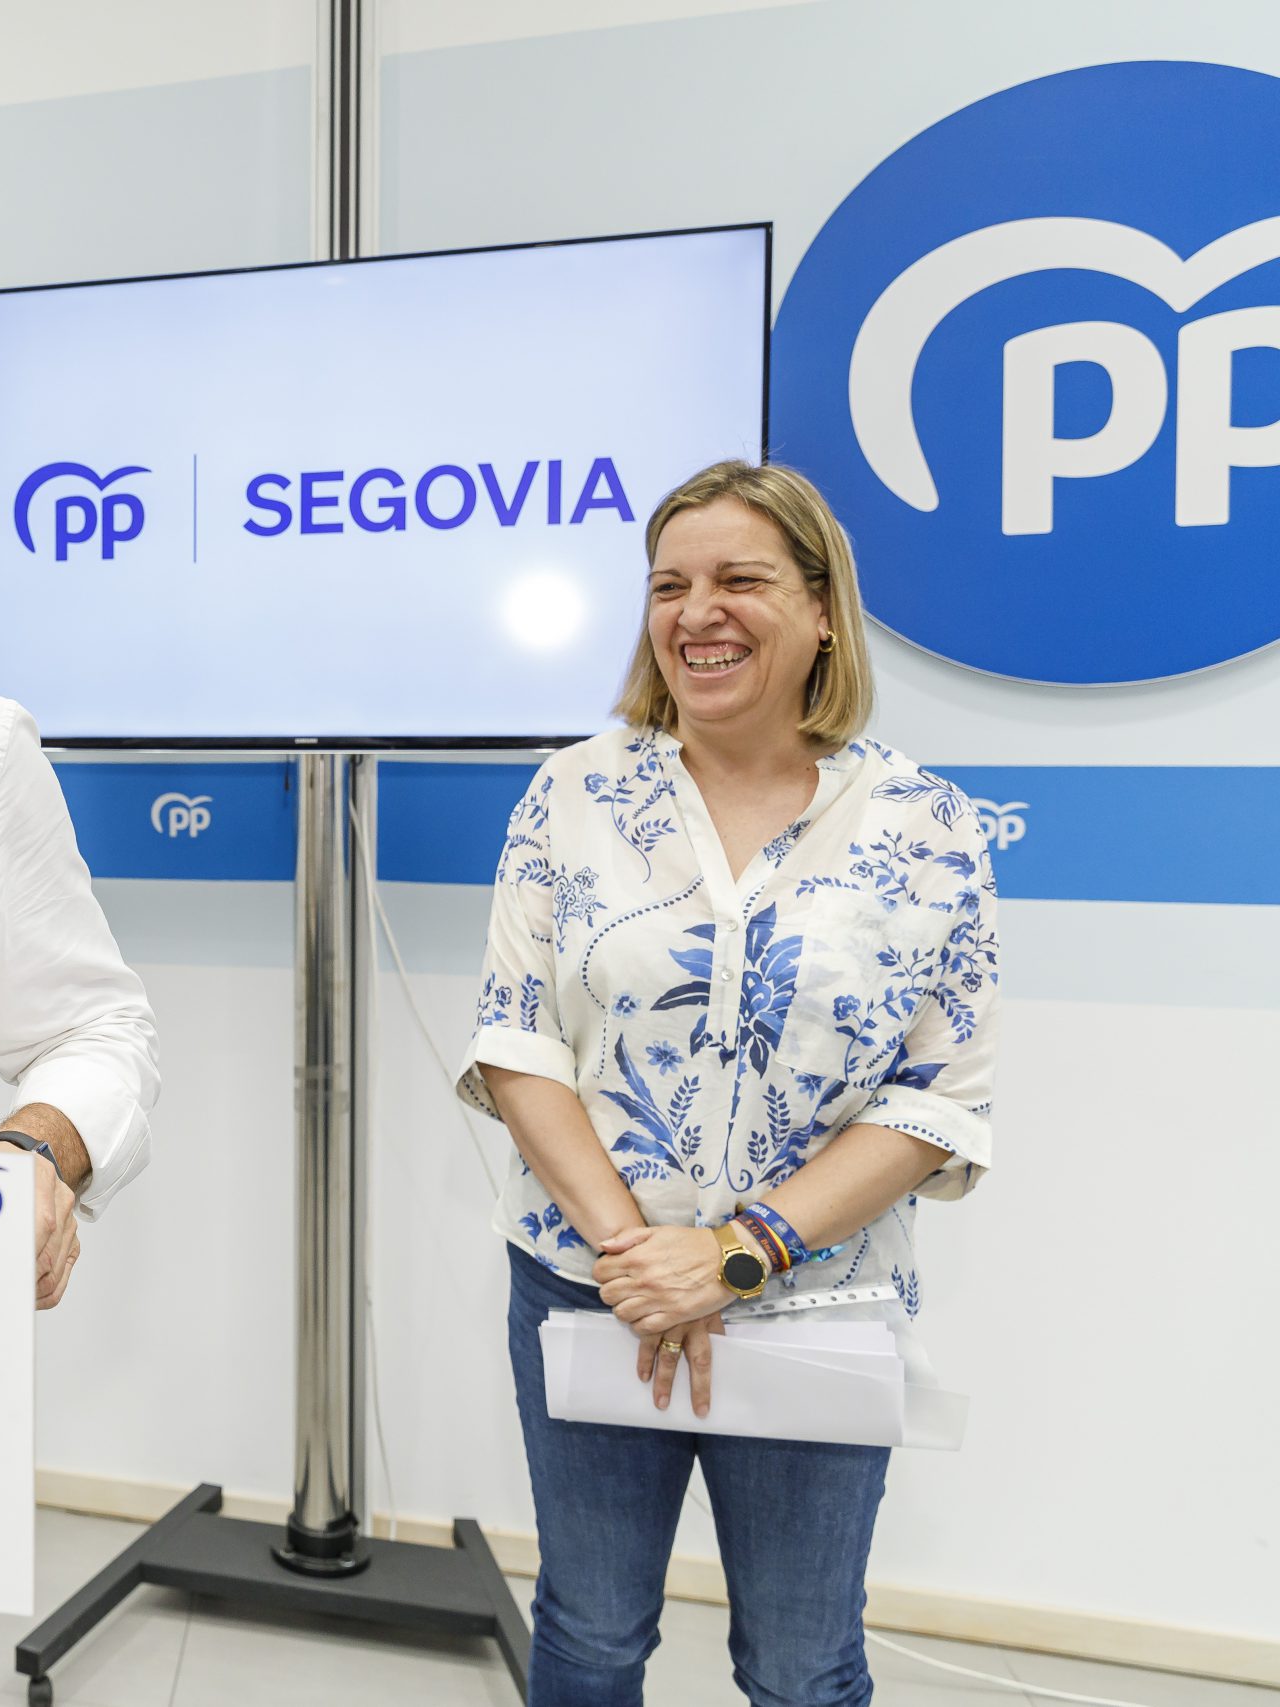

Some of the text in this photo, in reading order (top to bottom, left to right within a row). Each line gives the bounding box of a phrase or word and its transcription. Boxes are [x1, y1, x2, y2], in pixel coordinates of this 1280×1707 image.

[55, 457, 636, 561] pp SEGOVIA
[169, 806, 211, 837] pp
